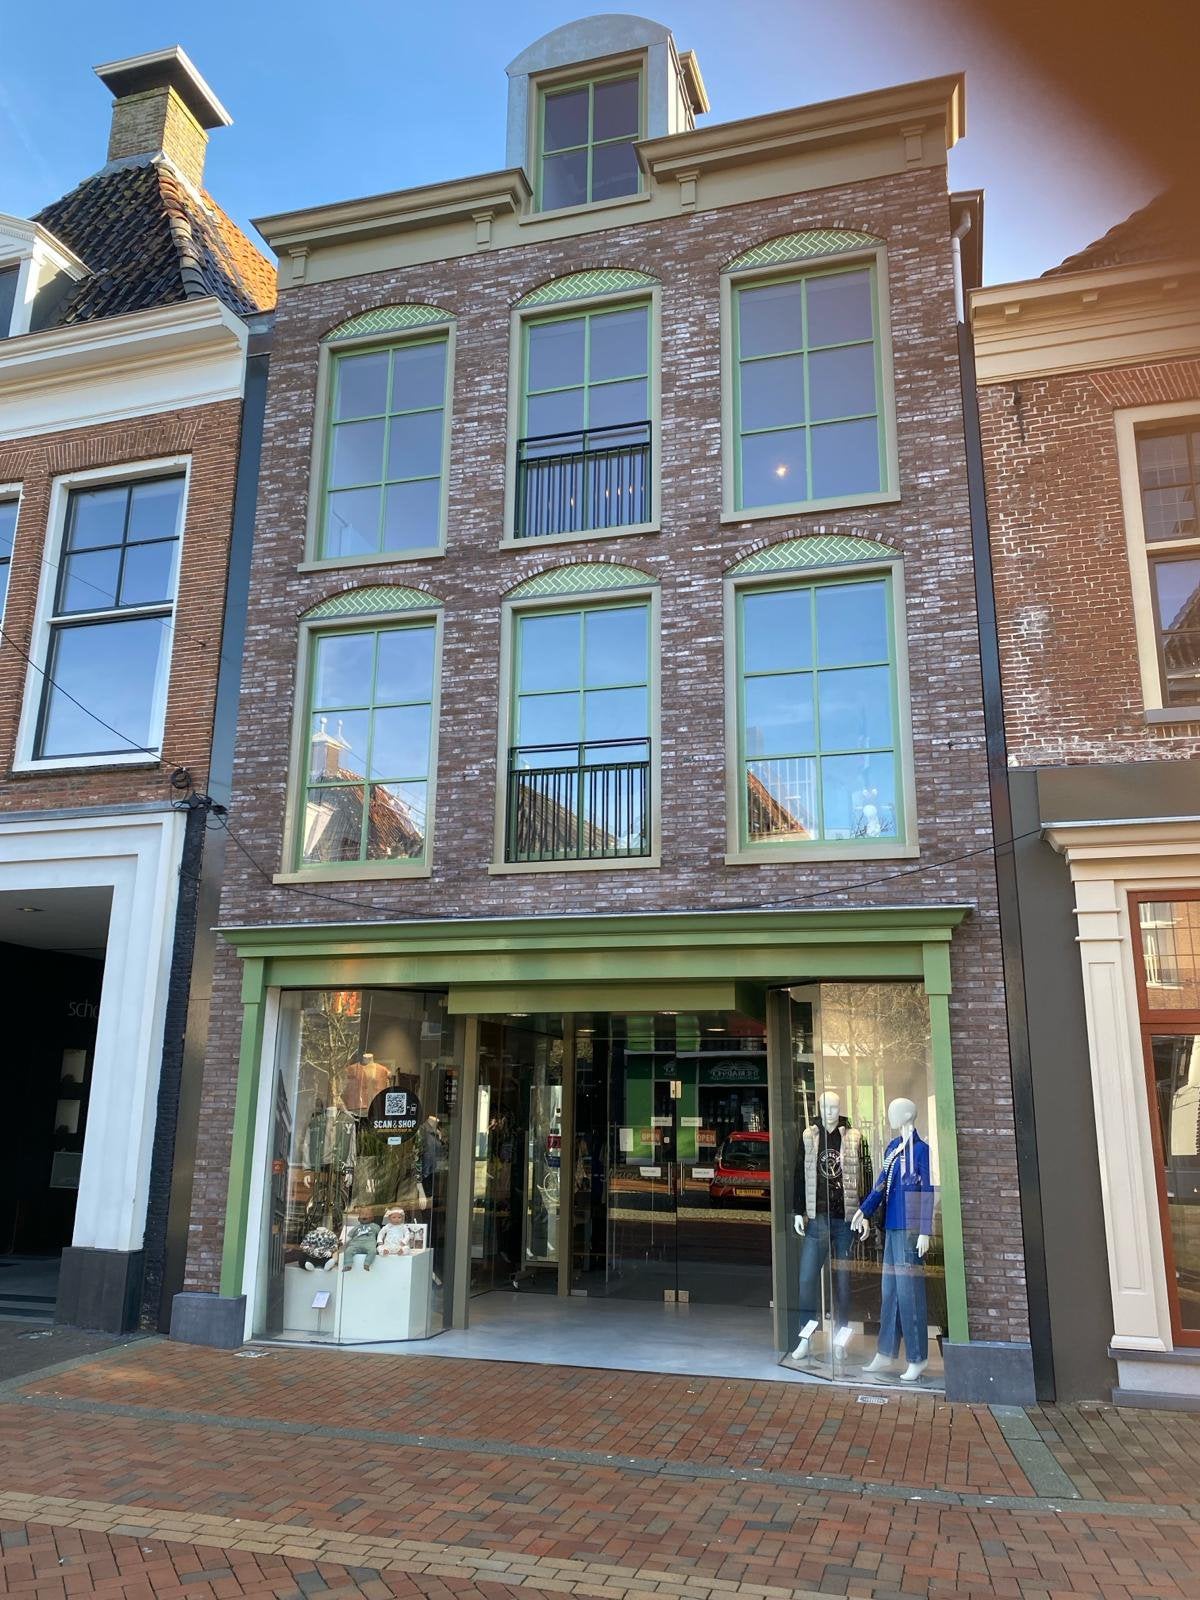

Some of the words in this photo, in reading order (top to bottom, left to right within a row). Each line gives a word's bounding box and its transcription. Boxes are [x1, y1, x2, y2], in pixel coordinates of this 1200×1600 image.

[373, 1120, 393, 1129] SCAN
[398, 1120, 416, 1128] SHOP
[696, 1134, 715, 1142] OPEN
